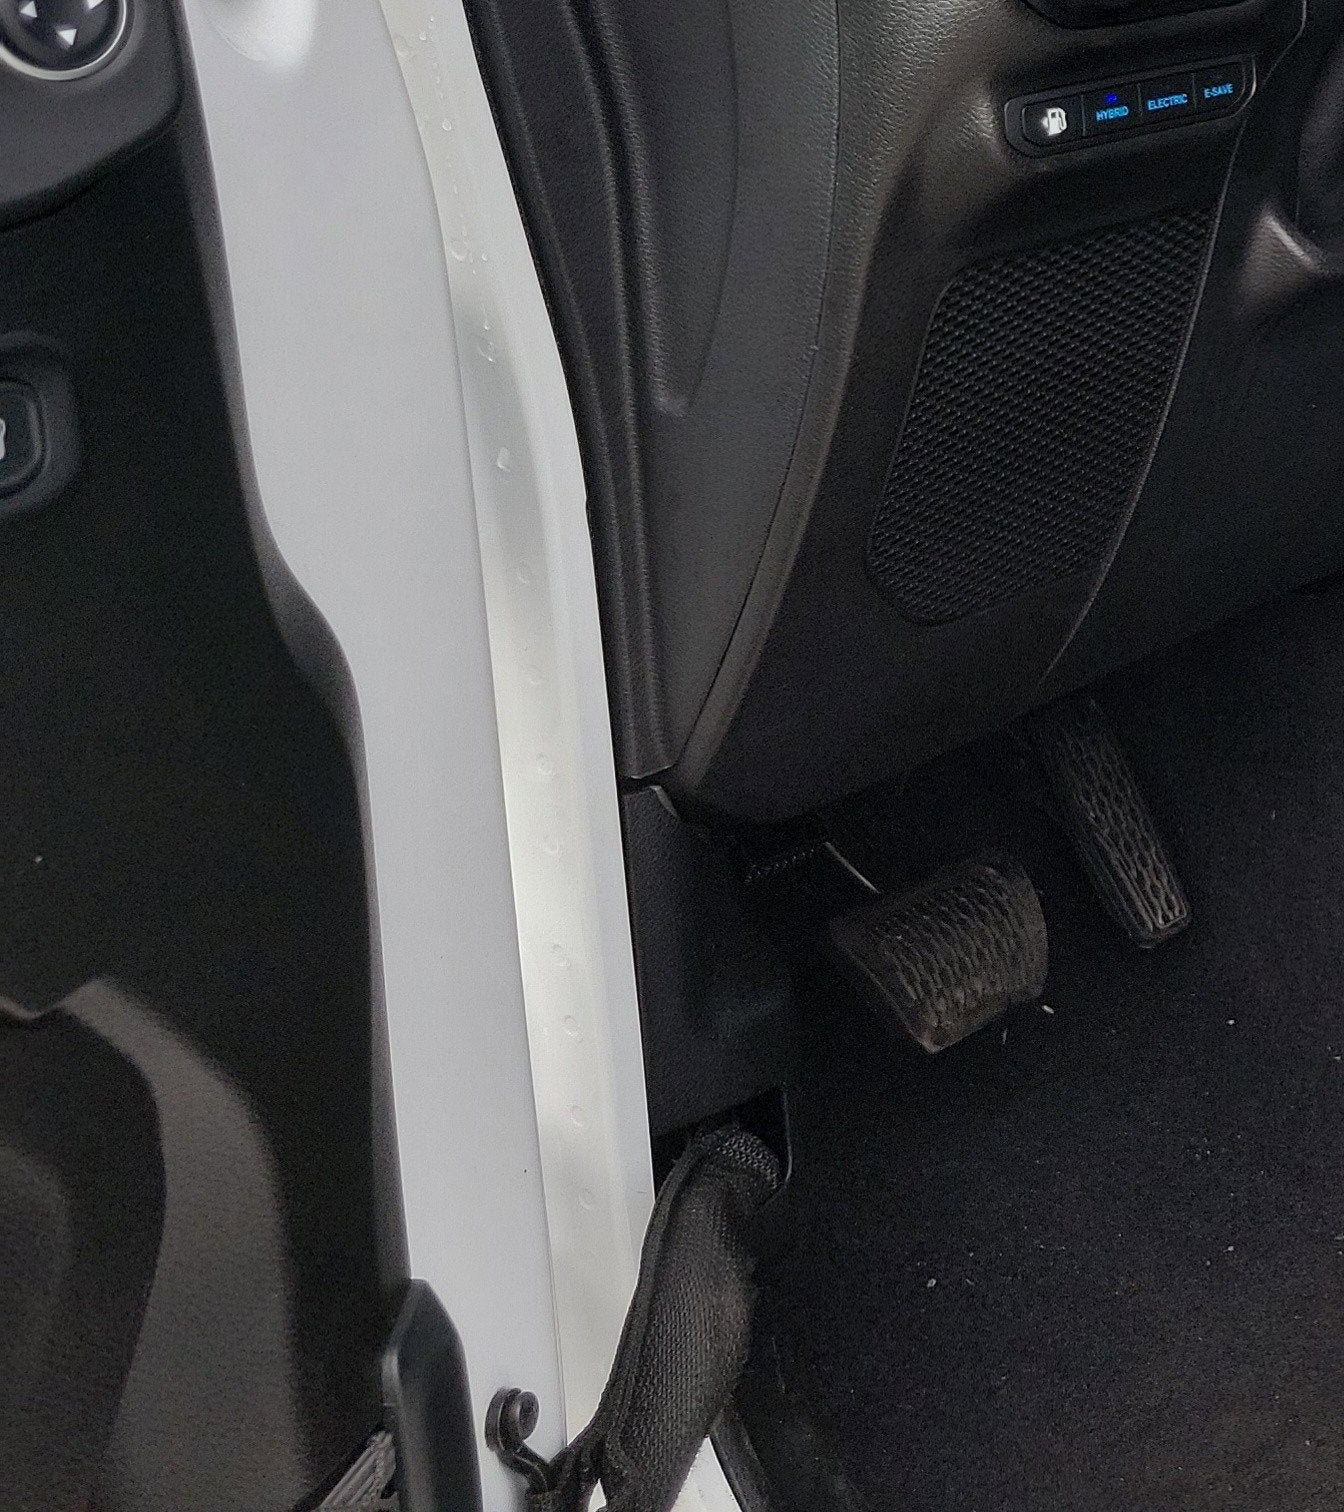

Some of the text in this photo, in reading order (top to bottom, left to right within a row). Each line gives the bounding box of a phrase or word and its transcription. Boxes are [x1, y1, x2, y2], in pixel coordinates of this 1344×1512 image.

[1203, 83, 1234, 99] E-SAVE
[1147, 93, 1188, 111] ELECTRIC
[1095, 105, 1130, 122] HYBRID
